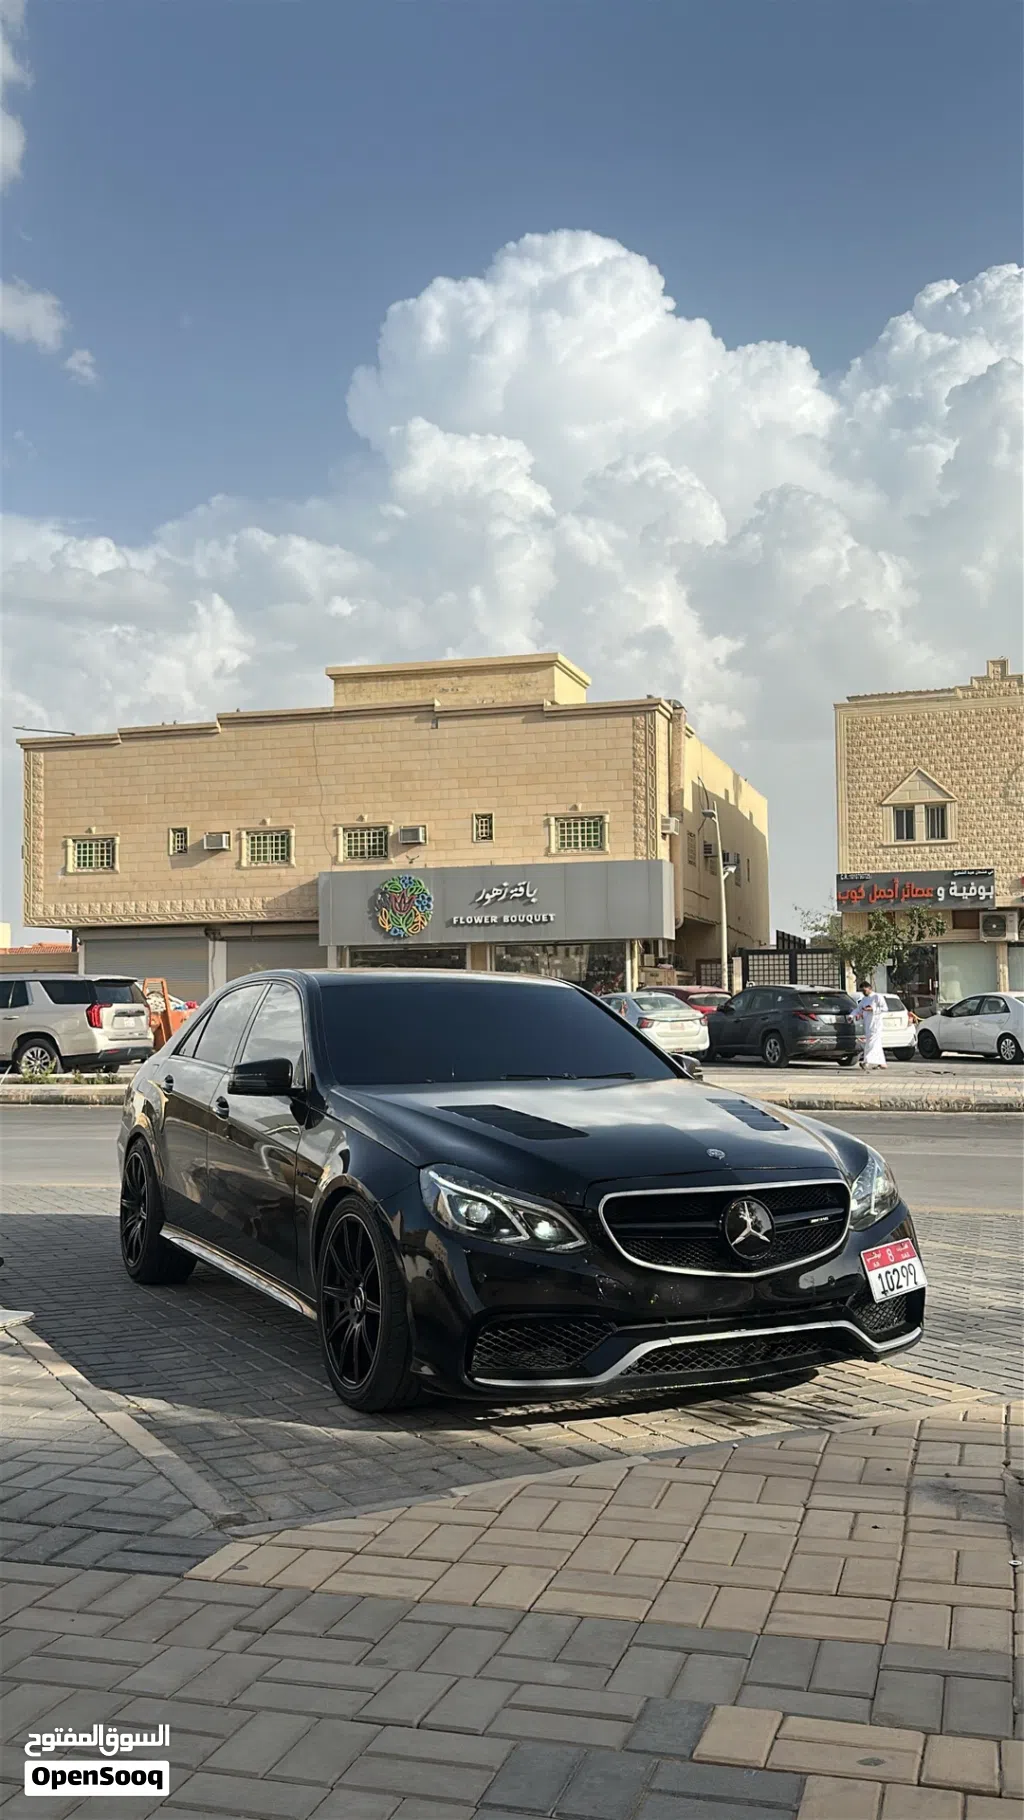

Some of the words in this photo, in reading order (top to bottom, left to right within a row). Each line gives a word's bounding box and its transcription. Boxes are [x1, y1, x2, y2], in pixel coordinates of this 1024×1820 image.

[475, 881, 510, 906] زهور
[510, 881, 538, 903] باقة
[837, 882, 866, 904] كوب
[869, 877, 899, 904] أجمل
[901, 881, 934, 902] عصائر
[937, 886, 945, 901] و
[949, 881, 994, 900] بوفية
[453, 915, 498, 925] FLOWER
[503, 913, 556, 924] BOUQUET
[886, 1248, 895, 1262] 8
[877, 1263, 918, 1295] 10299
